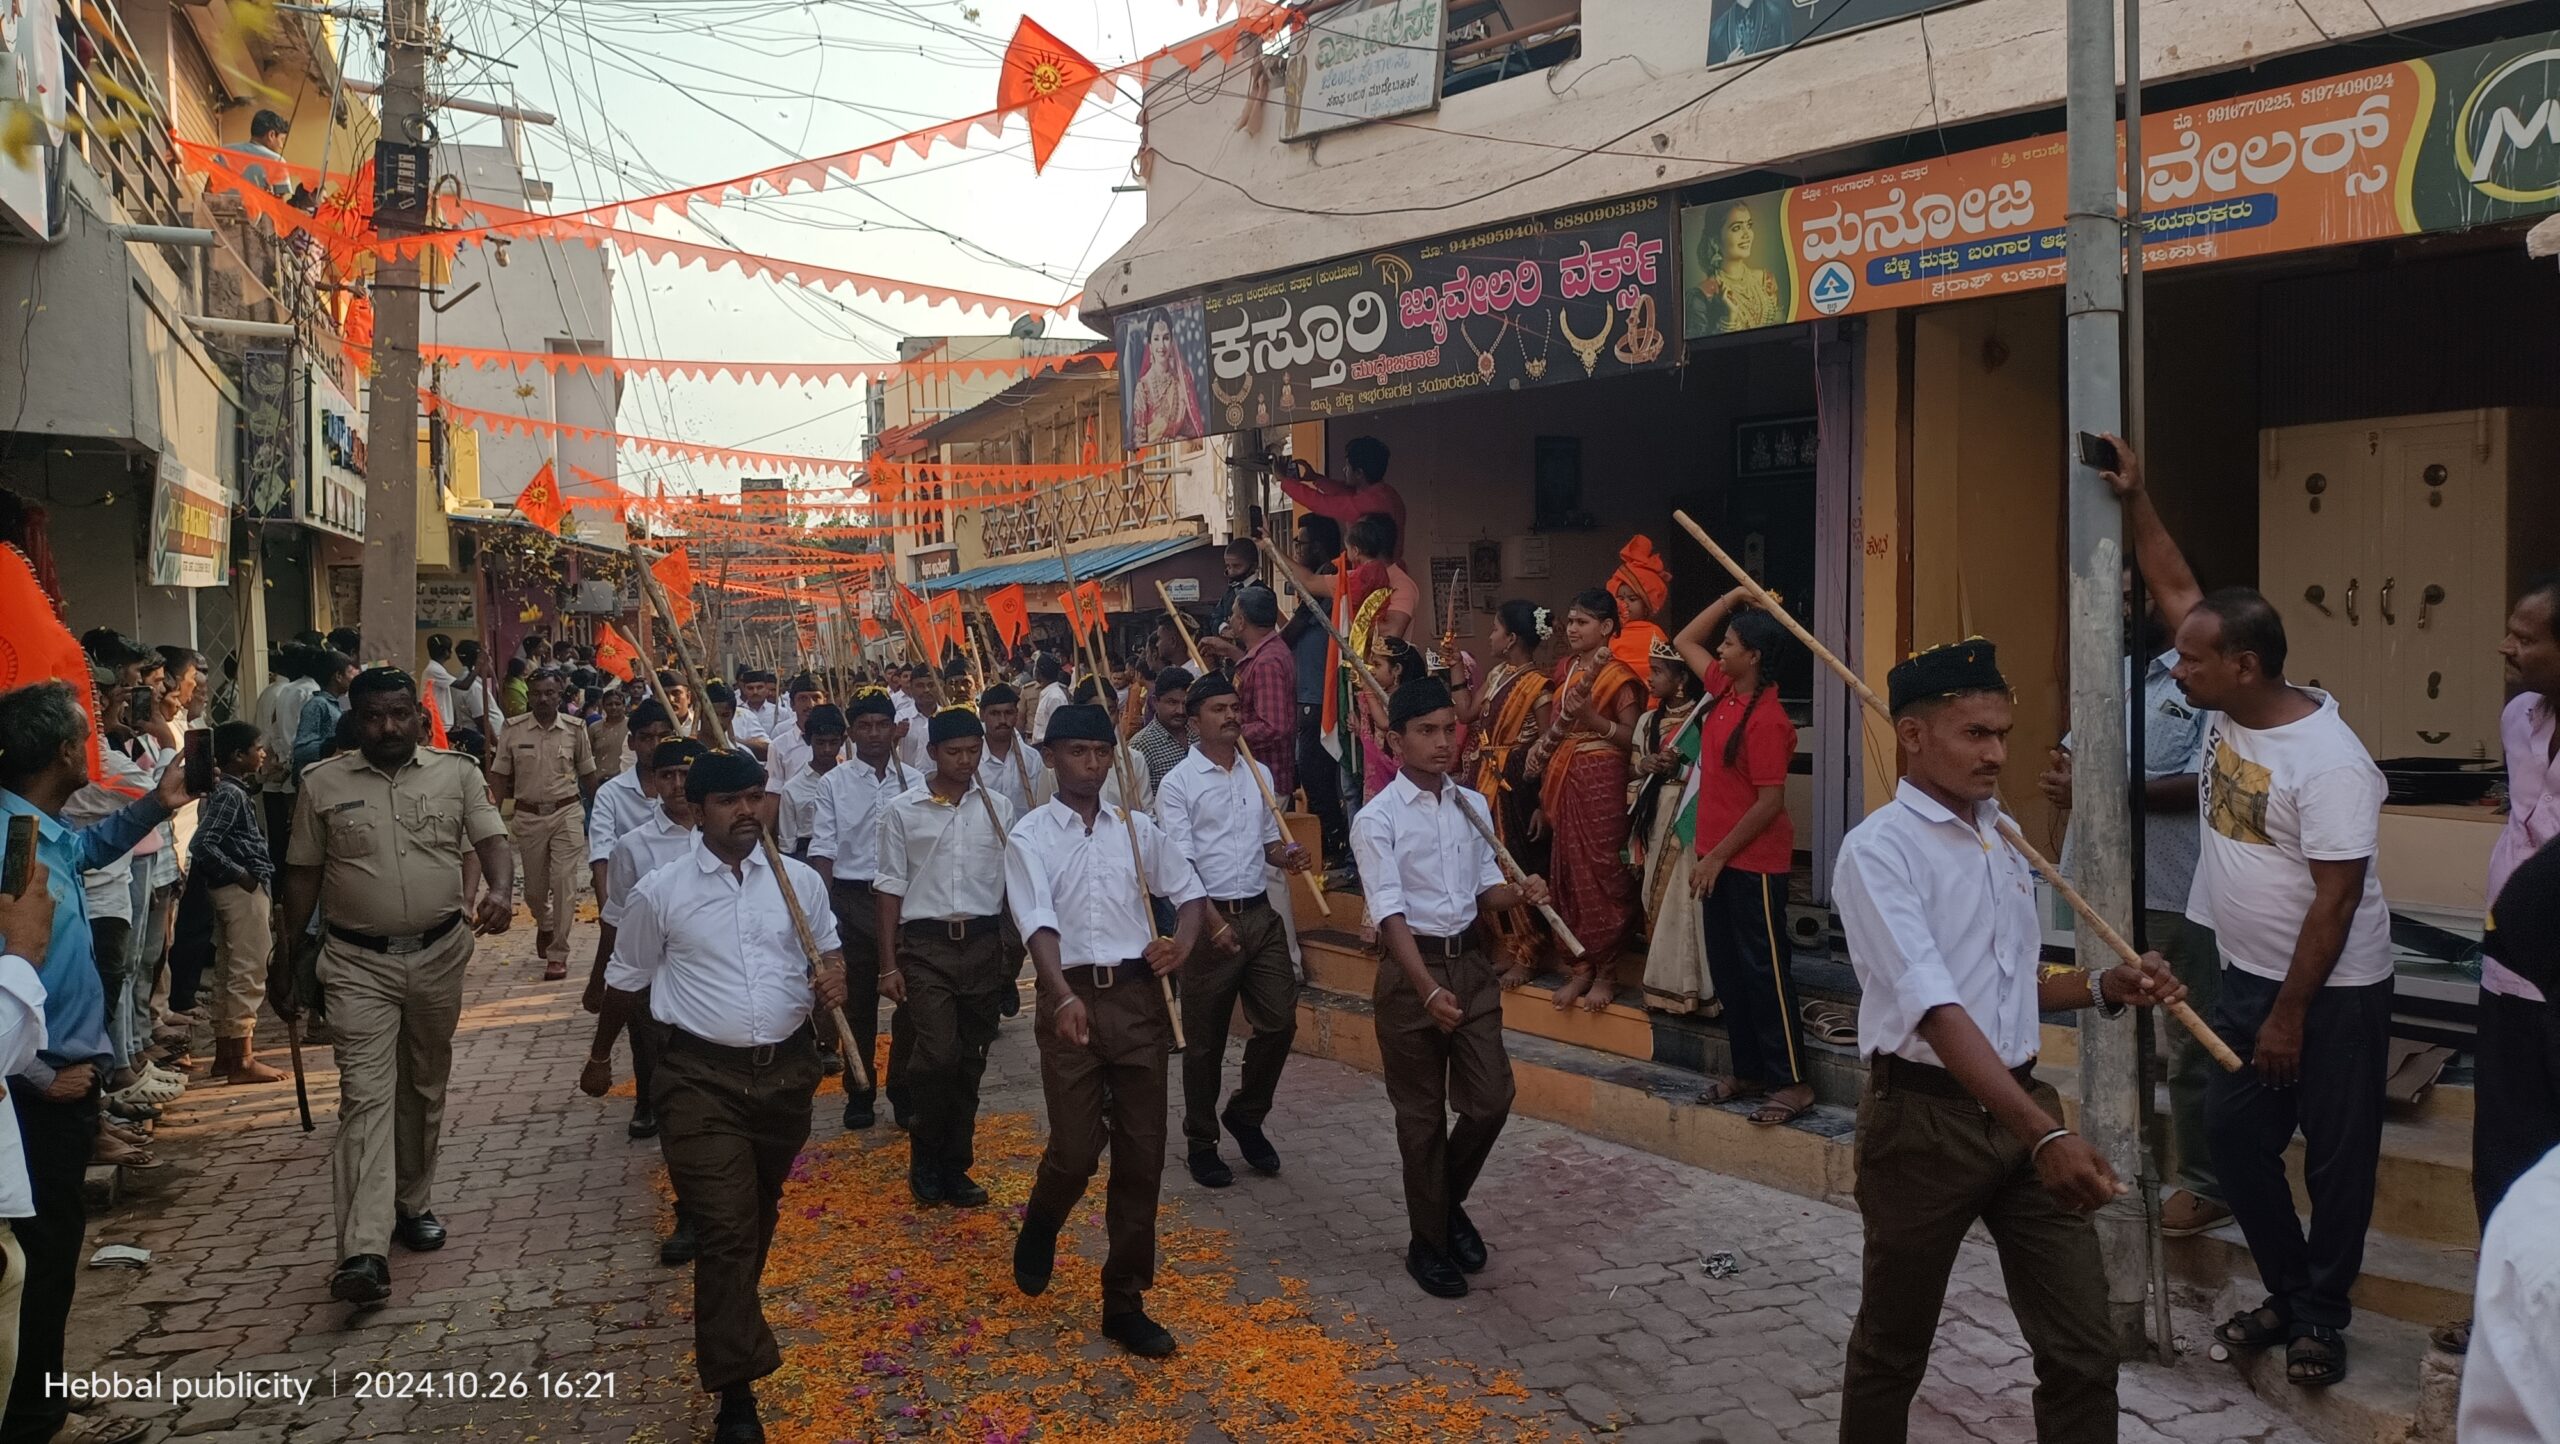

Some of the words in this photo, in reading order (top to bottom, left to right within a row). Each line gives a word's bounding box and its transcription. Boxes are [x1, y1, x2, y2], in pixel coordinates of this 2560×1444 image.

[2206, 92, 2296, 124] 9916770225,
[2300, 72, 2395, 105] 8197409024
[1553, 196, 1659, 231] 8880903398
[1802, 178, 2036, 263] ಮನೋಜ
[1918, 249, 1960, 271] ಮತ್ತು
[1967, 234, 2032, 261] ಬಂಗಾರ
[1399, 260, 1543, 344] ಜ್ಯುವೇಲರಿ
[1210, 290, 1388, 391] ಕಸ್ತೂರಿ
[1351, 346, 1441, 386] ಮುದ್ದೇಬಿಹಾಳ
[1358, 381, 1412, 405] ಆಭರಣಗಳ
[1417, 372, 1481, 394] ತಯಾರಕರು
